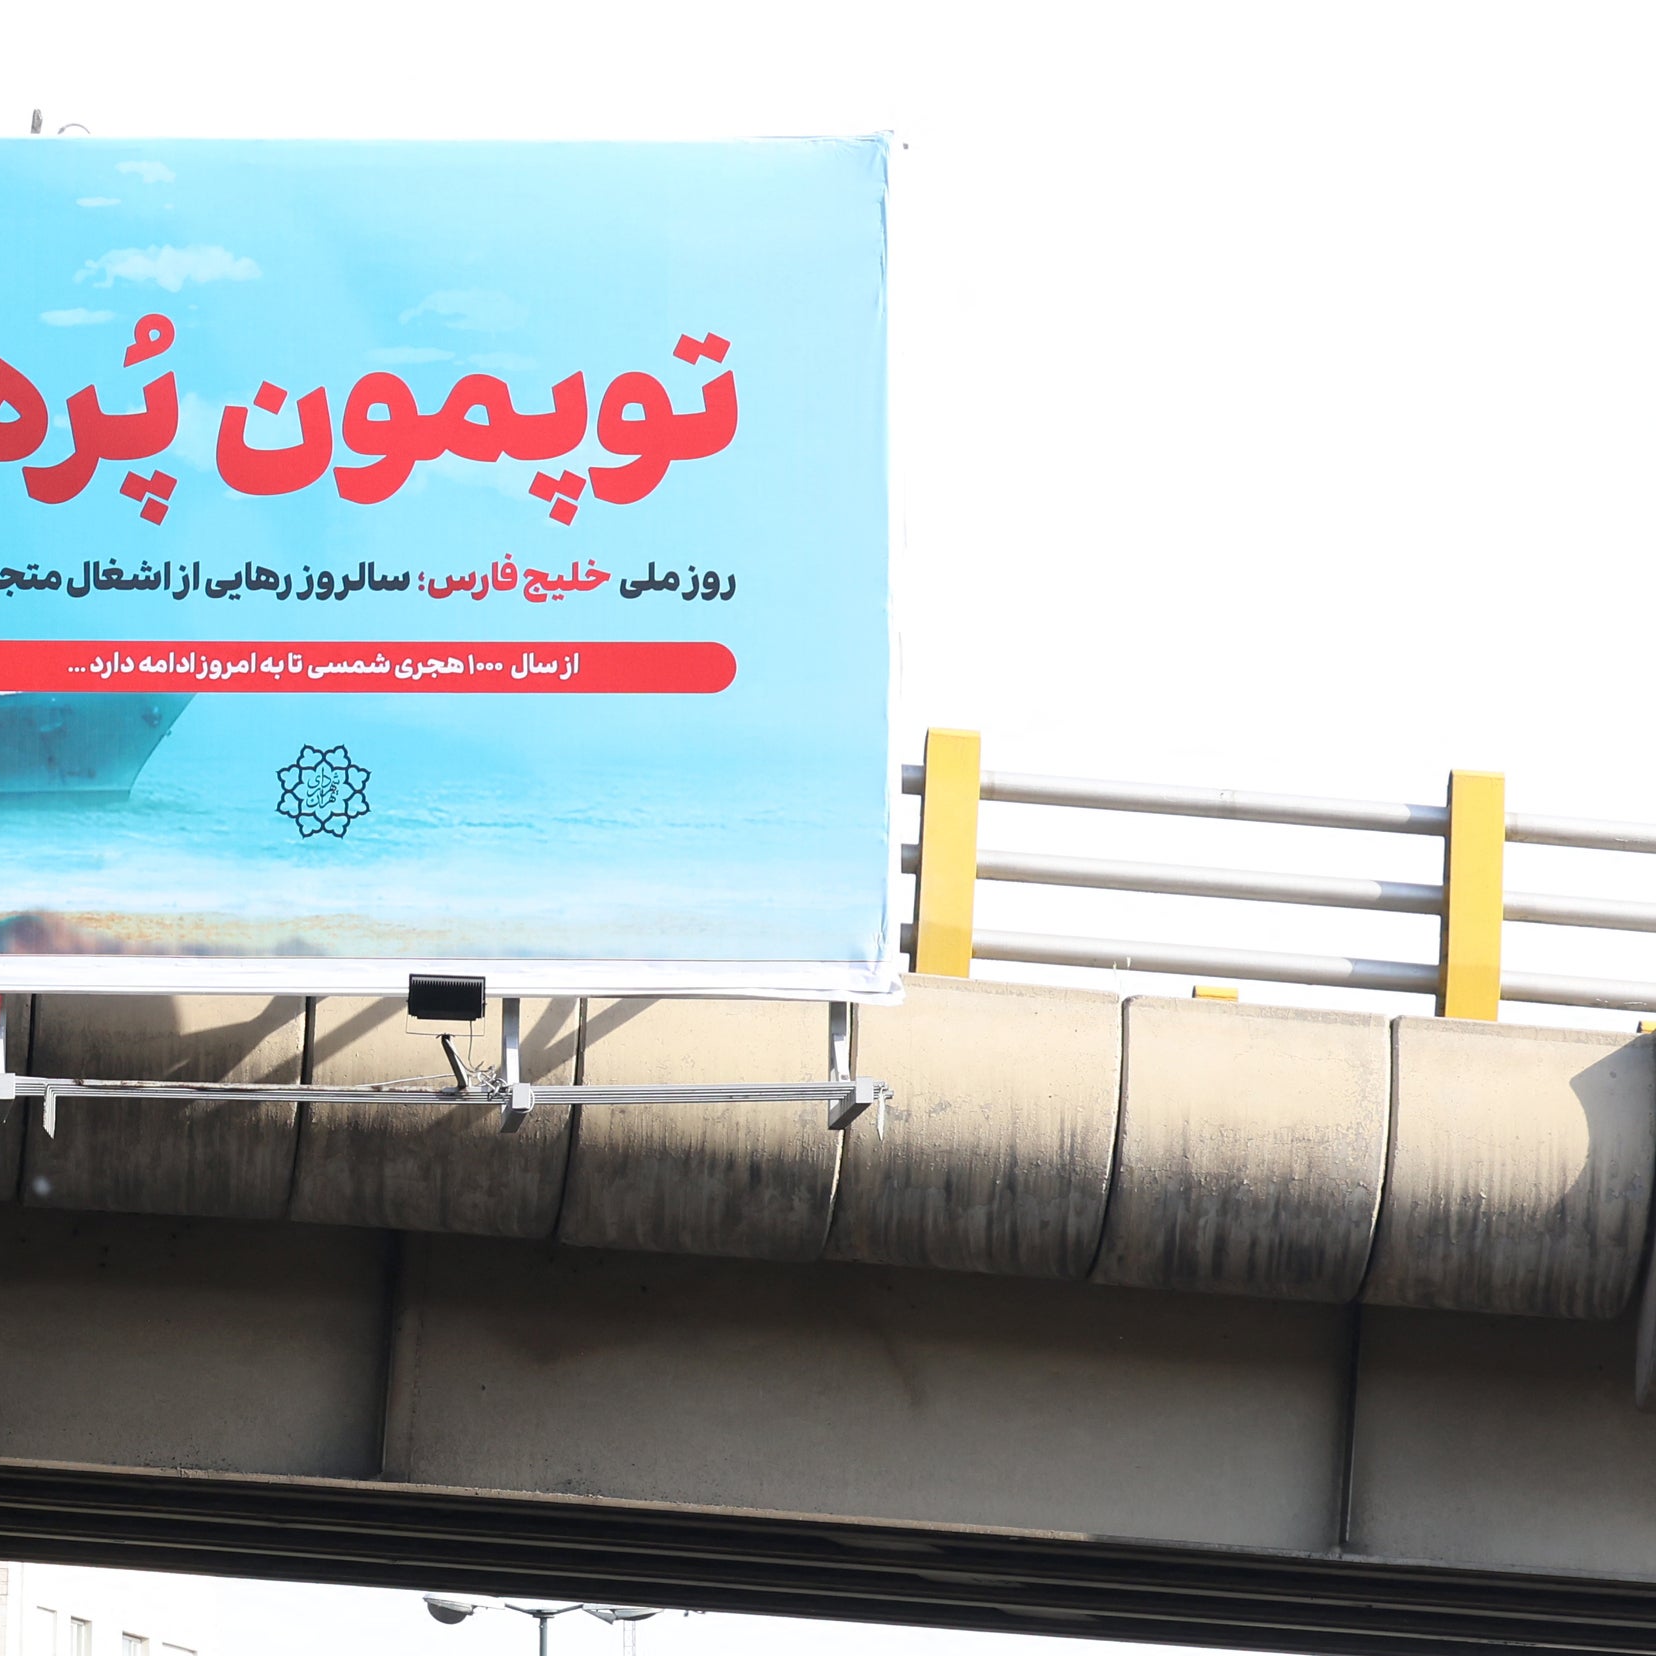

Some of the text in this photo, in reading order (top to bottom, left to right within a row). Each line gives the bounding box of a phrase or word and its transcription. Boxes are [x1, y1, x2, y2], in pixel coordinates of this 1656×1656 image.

[217, 333, 739, 526] توپمون
[66, 558, 171, 598] اشغال
[173, 561, 200, 601] از
[205, 561, 292, 601] رهایی
[296, 561, 411, 601] سالروز
[524, 558, 611, 603] خلیج
[619, 561, 680, 599] ملی
[681, 565, 737, 601] روز
[89, 651, 135, 680] دارد
[138, 651, 196, 674] ادامه
[195, 652, 257, 680] امروز
[259, 656, 285, 680] به
[287, 652, 303, 674] تا
[307, 653, 391, 681] شمسی
[394, 656, 465, 681] هجری
[467, 653, 504, 675] ۱۰۰۰
[510, 652, 558, 680] سال
[559, 652, 579, 681] از
